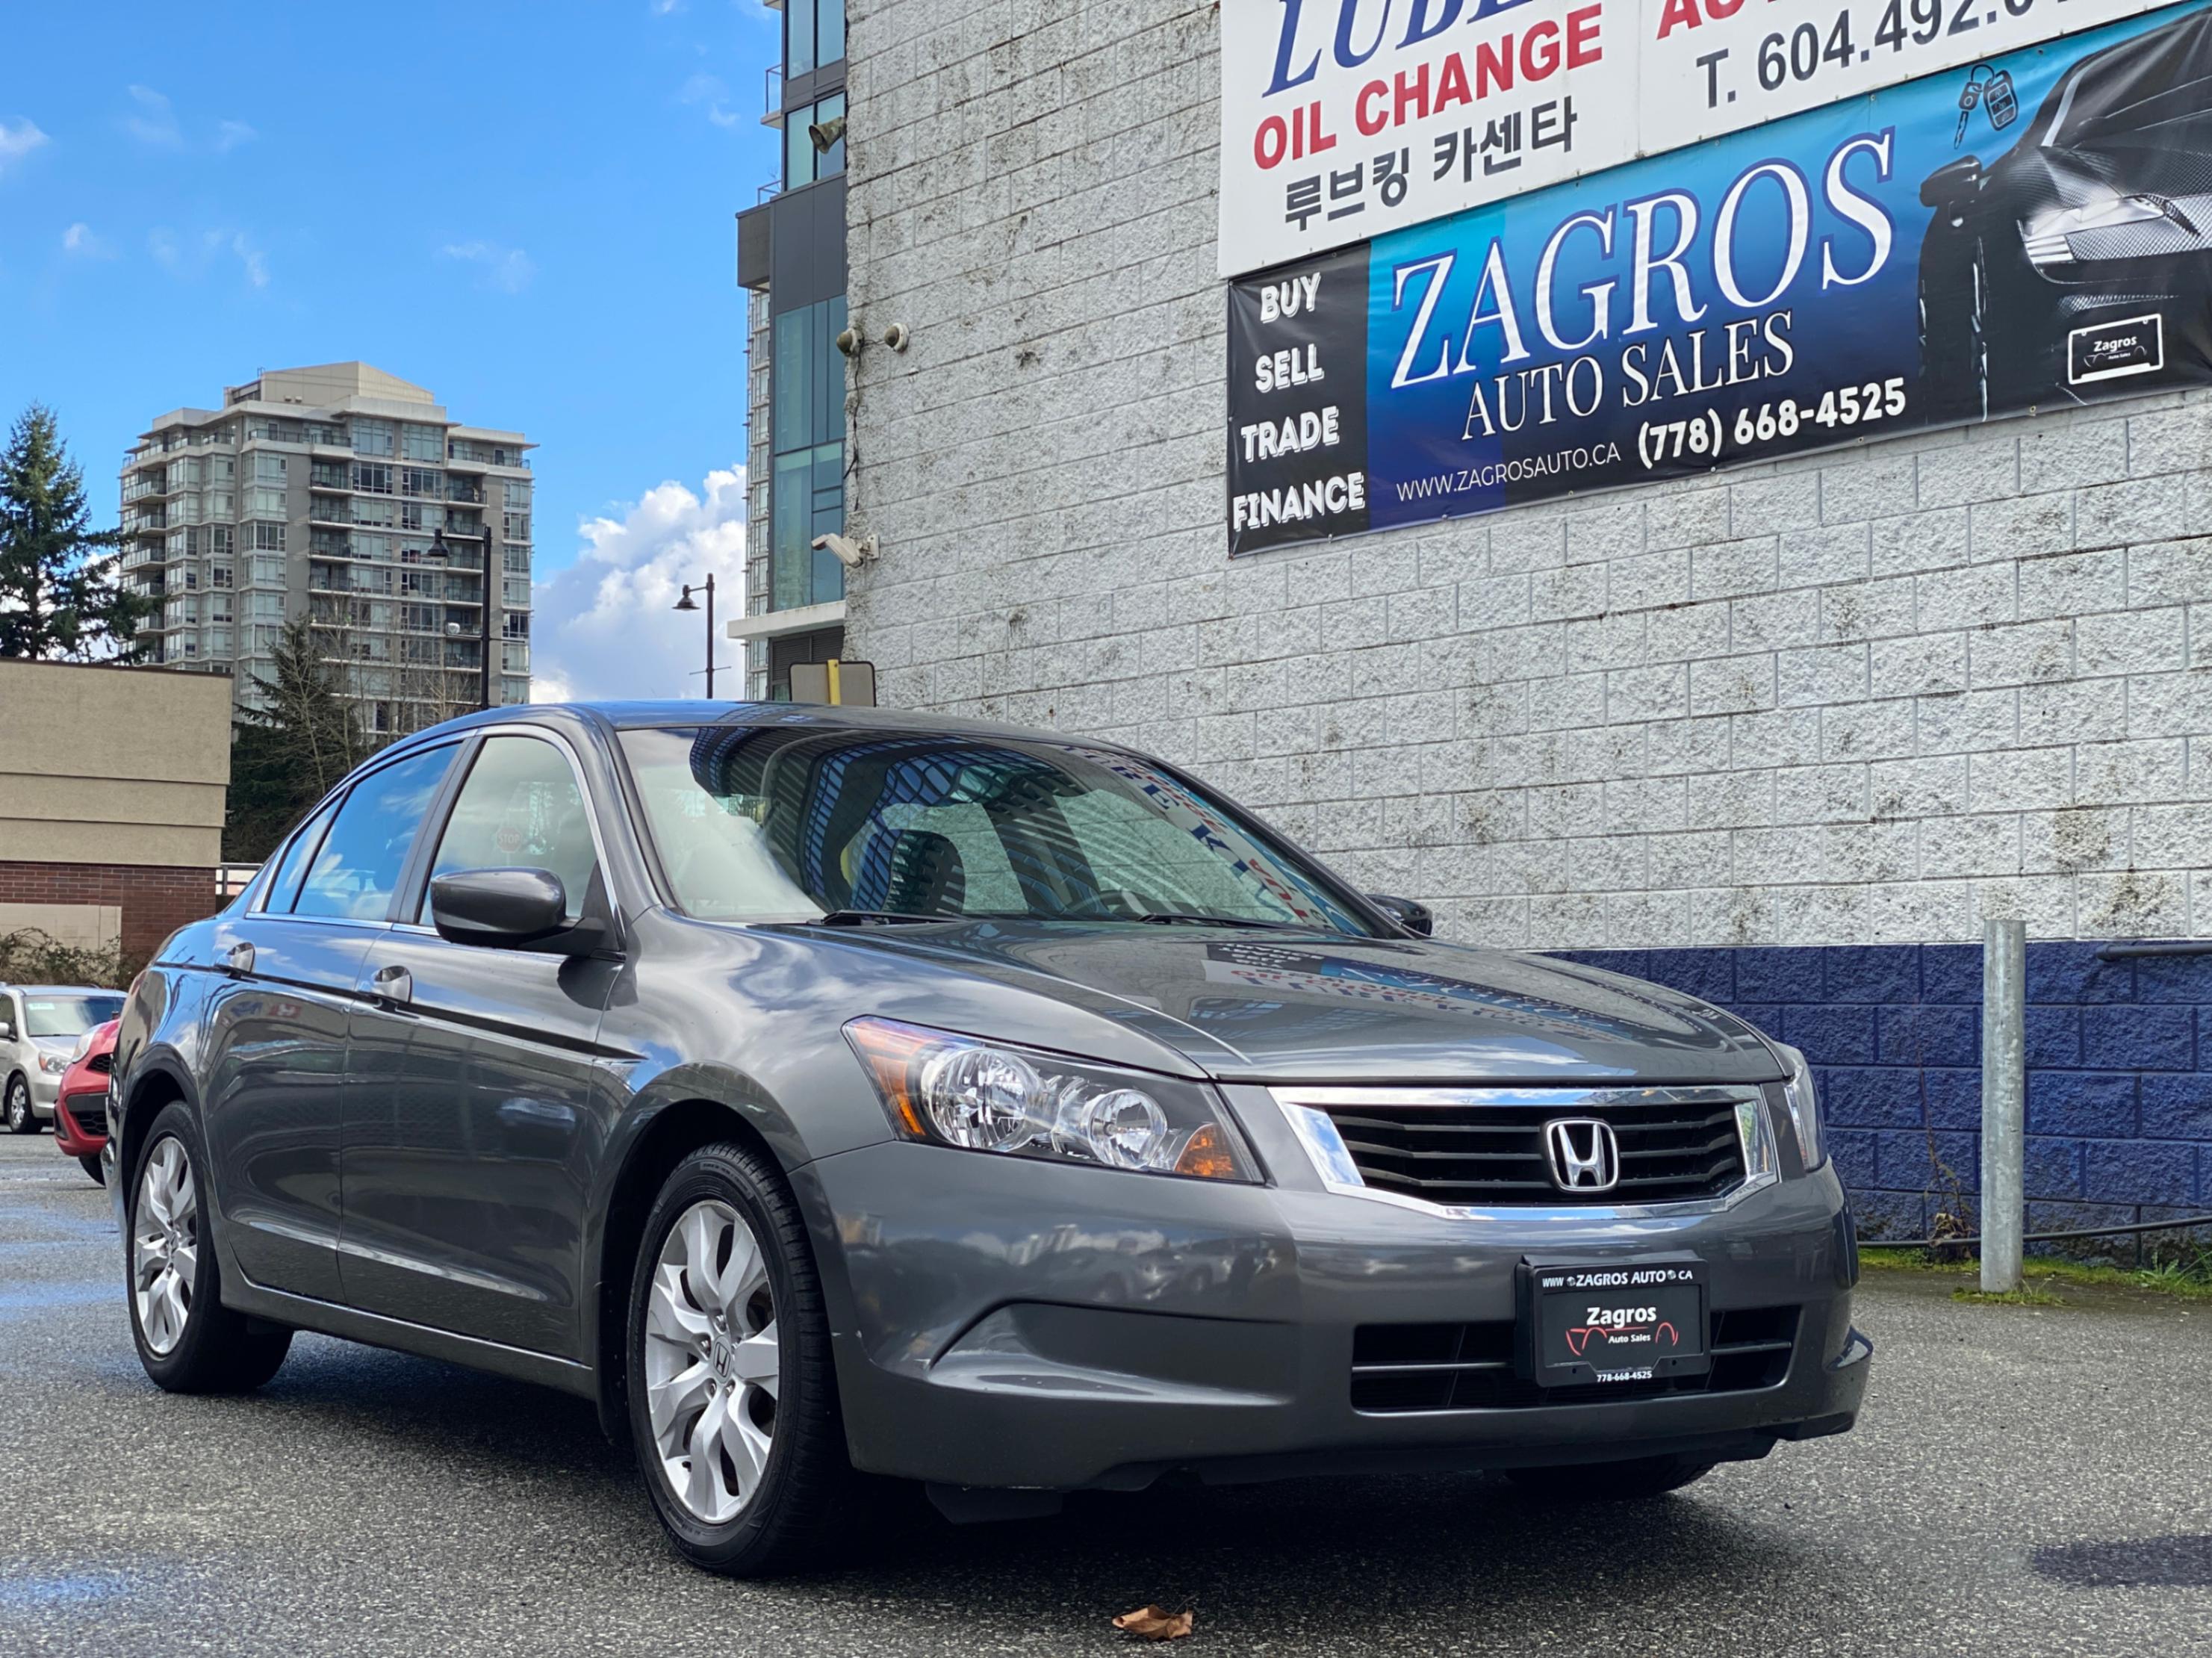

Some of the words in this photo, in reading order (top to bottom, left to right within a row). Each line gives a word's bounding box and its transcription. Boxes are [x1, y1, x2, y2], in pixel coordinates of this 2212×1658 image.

[1254, 100, 1337, 170] OIL
[1355, 3, 1603, 137] CHANGE
[1284, 147, 1410, 232] 루브킹
[1433, 95, 1578, 183] 카센타
[1391, 126, 1895, 389] ZAGROS
[1260, 271, 1322, 323] BUY
[1255, 343, 1325, 393] SELL
[2093, 336, 2137, 353] Zagros
[1461, 354, 1604, 441] AUTO
[1621, 309, 1794, 409] SALES
[1240, 405, 1340, 463] TRADE
[1638, 408, 1722, 471] (778)
[1734, 377, 1907, 447] 668-4525
[1396, 441, 1621, 502] WWW.ZAGROSAUTO.CA
[1232, 471, 1366, 532] FINANCE
[1575, 1272, 1629, 1287] ZAGROS
[1630, 1270, 1667, 1284] AUTO
[1677, 1270, 1694, 1280] CA
[1585, 1306, 1657, 1329] Zagros
[1607, 1335, 1629, 1344] Auto
[1630, 1333, 1651, 1343] Sales
[1596, 1370, 1653, 1383] 778-668-4525
